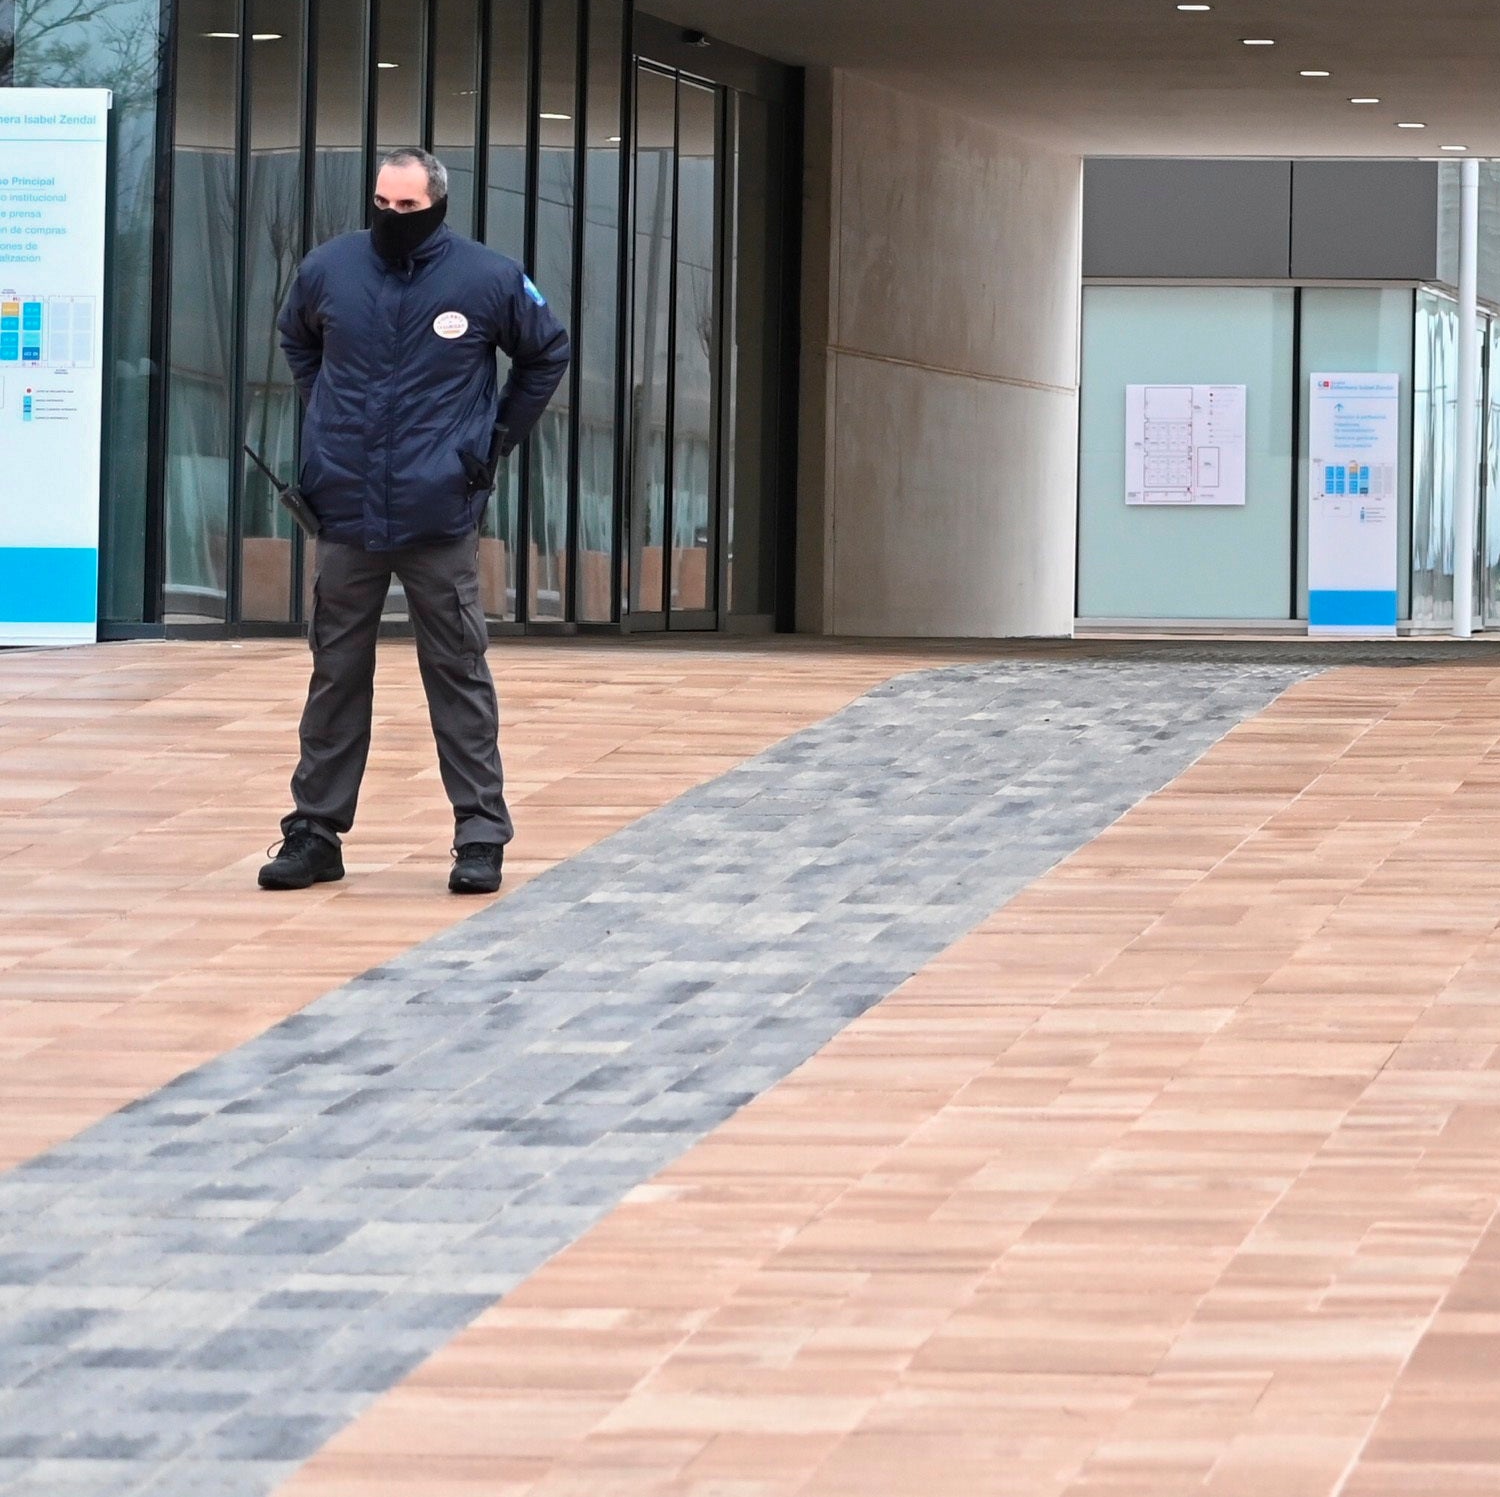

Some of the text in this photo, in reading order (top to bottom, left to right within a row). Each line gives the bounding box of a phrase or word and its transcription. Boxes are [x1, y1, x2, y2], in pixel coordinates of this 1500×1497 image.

[24, 114, 56, 125] Isabel
[59, 114, 96, 125] Zendal
[11, 176, 55, 187] Principal
[9, 192, 67, 203] institucional
[9, 210, 42, 220] prensa
[10, 225, 22, 235] de
[24, 226, 67, 237] compras
[25, 242, 38, 251] de
